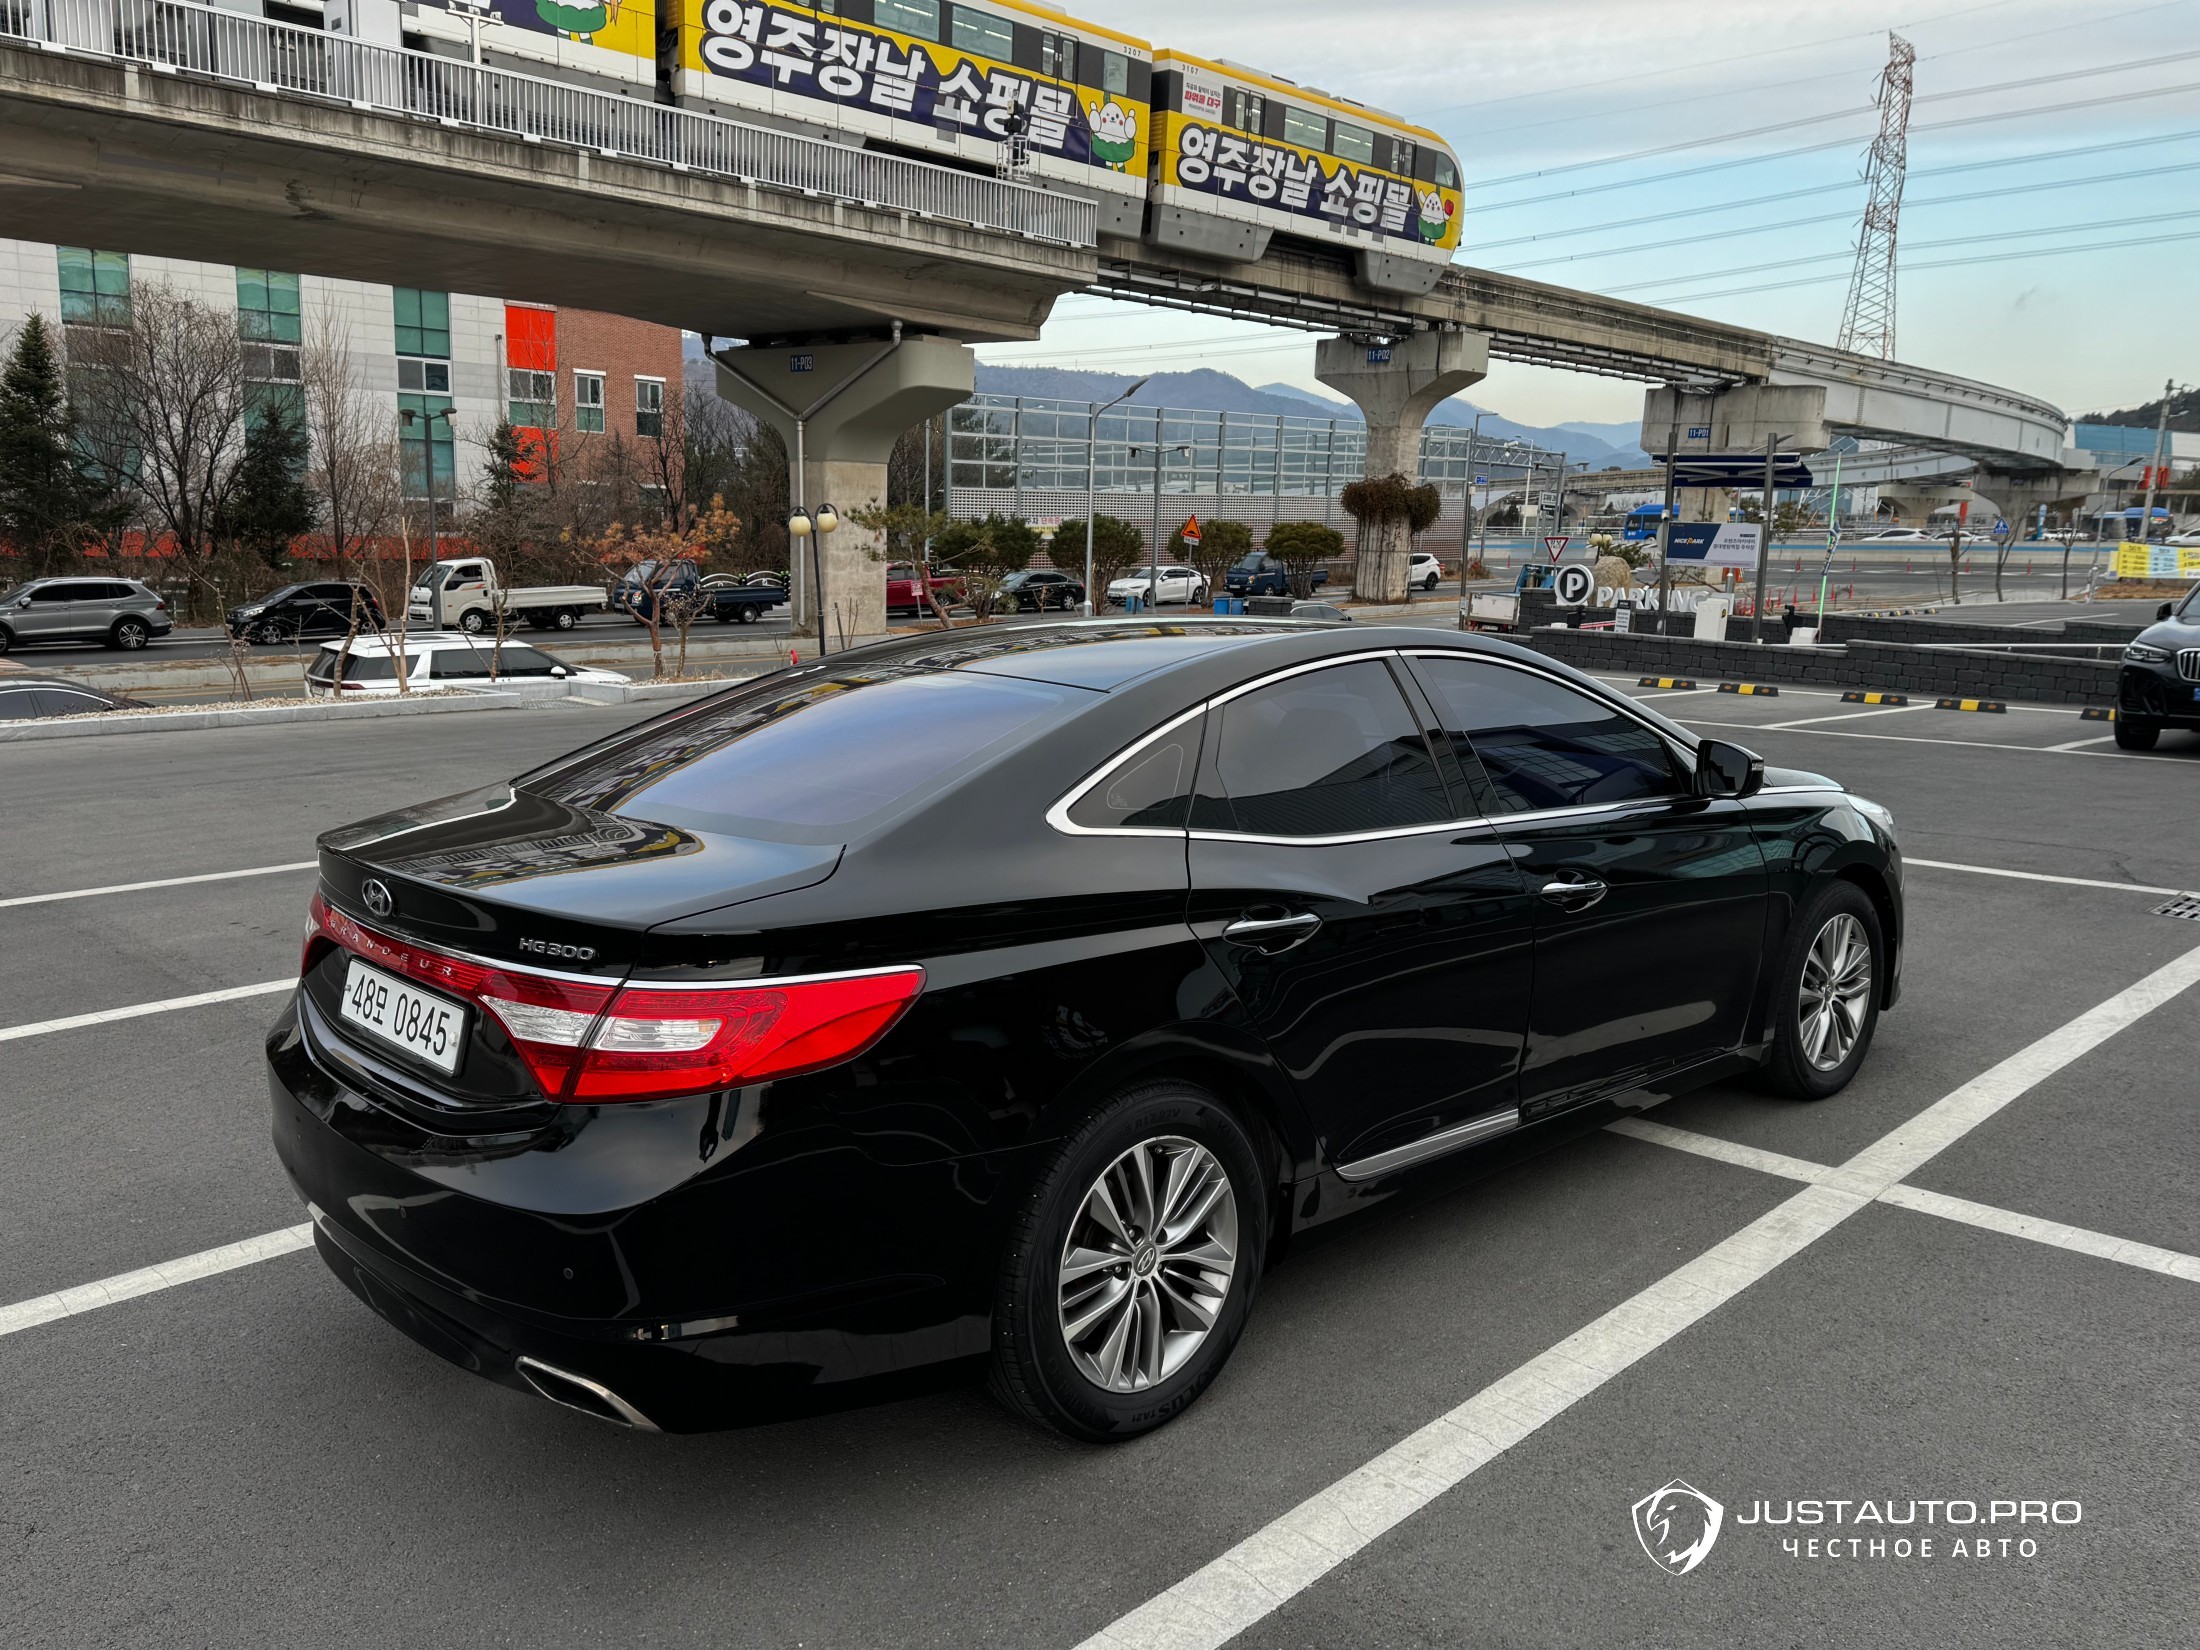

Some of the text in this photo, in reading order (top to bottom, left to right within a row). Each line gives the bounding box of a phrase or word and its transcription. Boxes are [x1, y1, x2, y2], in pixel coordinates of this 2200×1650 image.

[1123, 45, 1142, 58] 3207
[704, 0, 1072, 149] 영주장날 쇼핑몰
[1182, 64, 1199, 75] 3107
[1207, 97, 1221, 108] 대구
[1178, 127, 1412, 232] 영주장날 쇼핑몰
[790, 355, 813, 371] 11-P03
[1367, 349, 1390, 362] 11-P02
[1689, 428, 1710, 439] 11-P01
[1566, 573, 1585, 599] P
[330, 919, 452, 976] GRANDEUR
[518, 936, 598, 961] HG300
[351, 973, 451, 1056] 48모 0845
